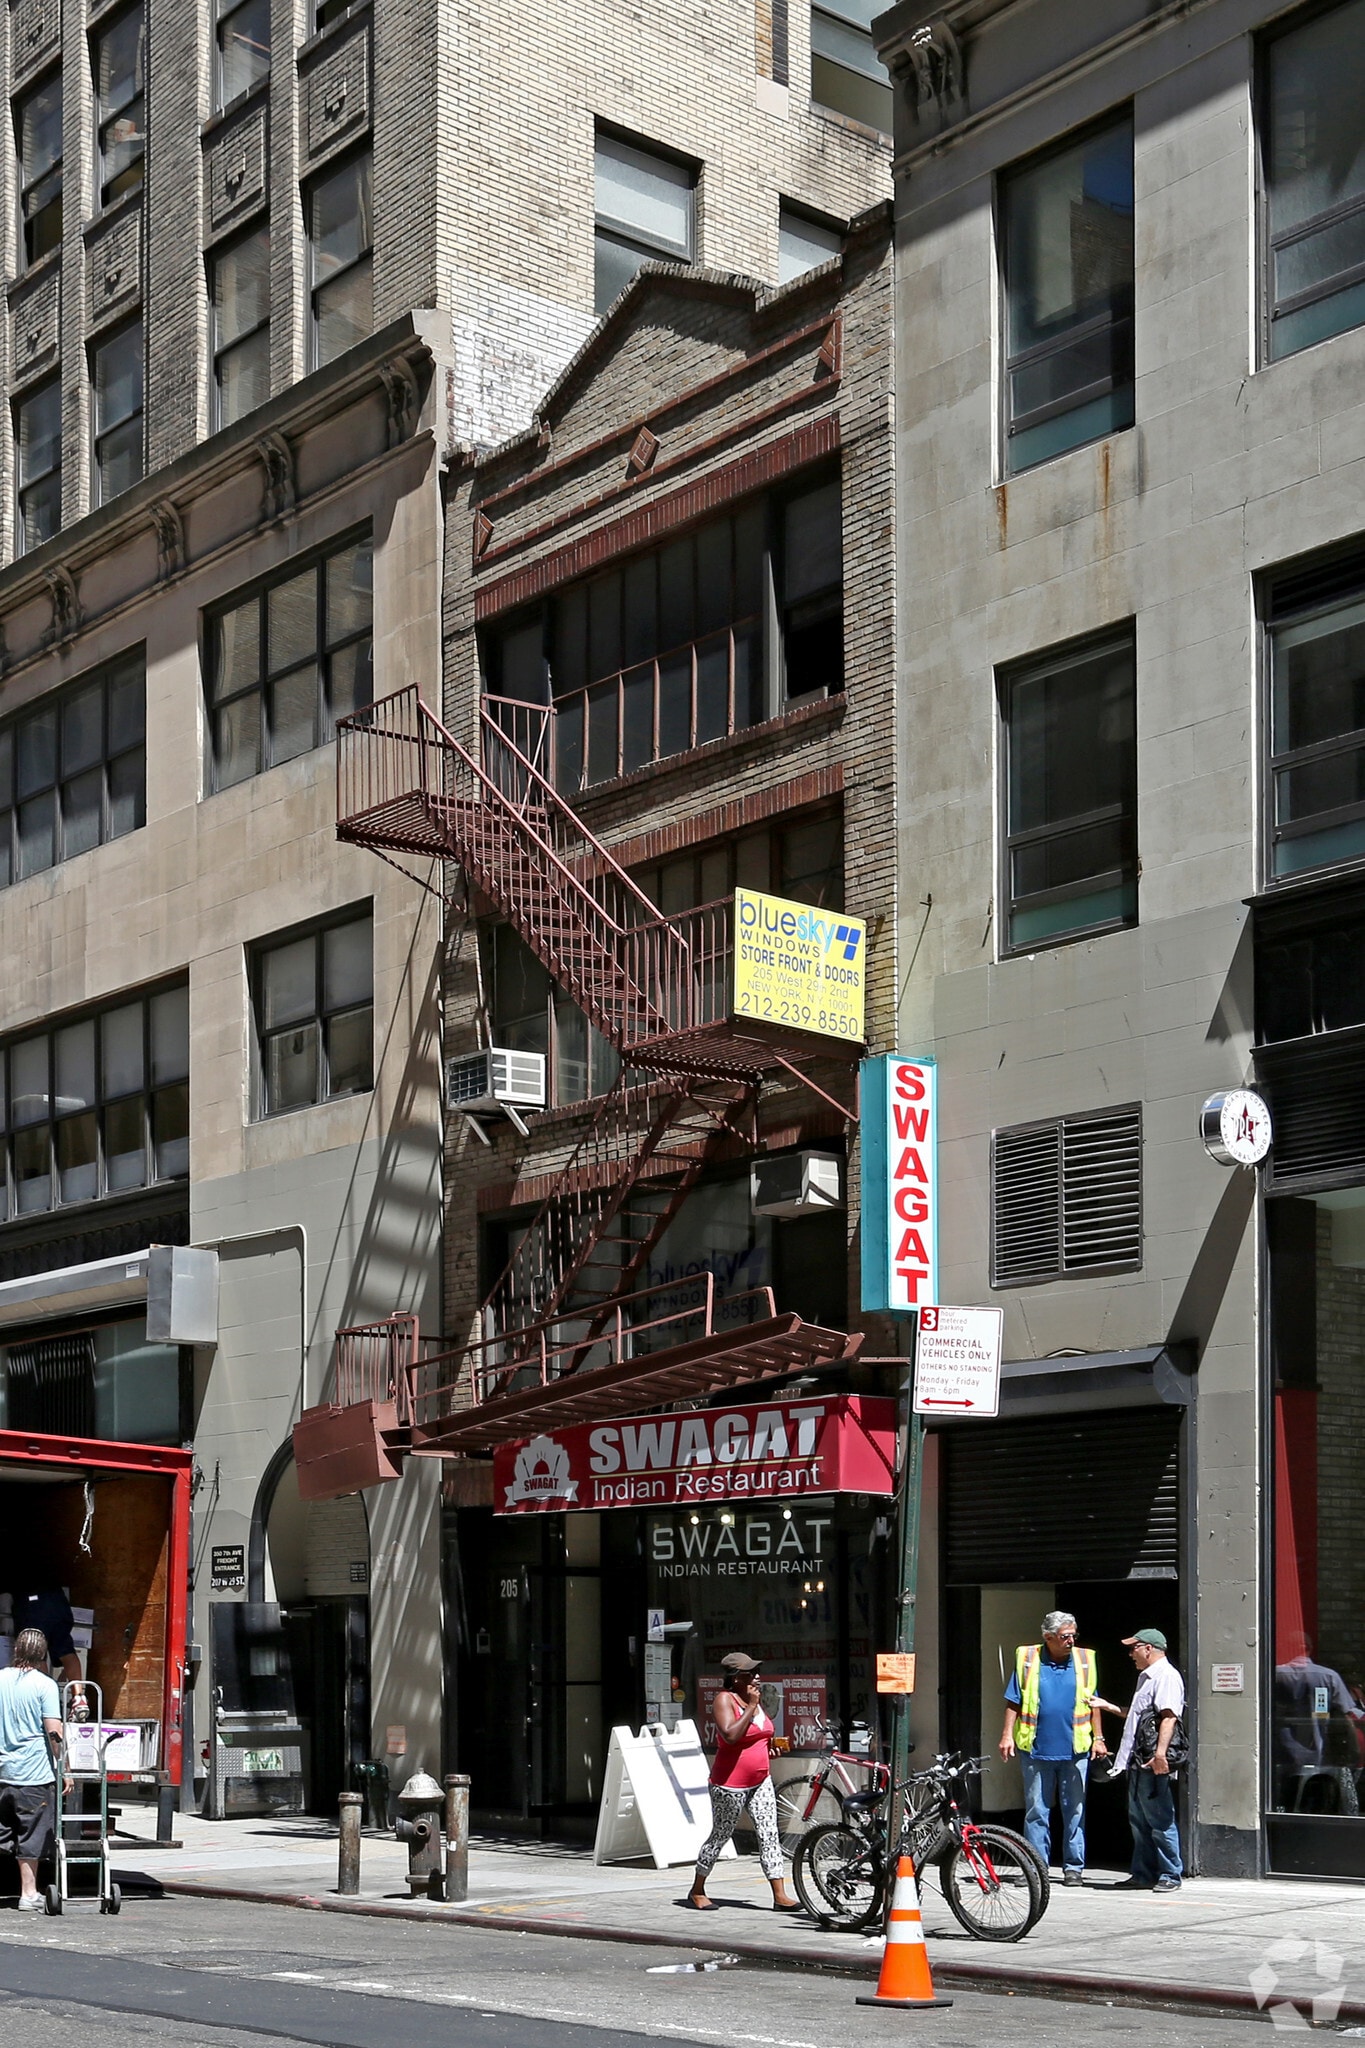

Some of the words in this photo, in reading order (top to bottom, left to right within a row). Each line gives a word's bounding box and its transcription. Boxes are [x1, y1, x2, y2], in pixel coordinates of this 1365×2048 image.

[740, 893, 836, 953] bluesky
[740, 929, 820, 958] WINDOWS
[741, 944, 775, 967] STORE
[778, 953, 812, 975] FRONT
[815, 963, 822, 978] &
[825, 965, 860, 987] DOORS
[752, 966, 773, 981] 205
[777, 970, 803, 987] West
[830, 985, 848, 999] 2nd
[747, 980, 771, 993] NEW
[829, 998, 854, 1013] 10001
[741, 992, 858, 1037] 212-239-8550
[1223, 1091, 1247, 1119] ORGANIC
[1250, 1094, 1269, 1126] COFFEE
[1224, 1133, 1251, 1161] NATURAL
[1253, 1139, 1267, 1157] FOOD
[892, 1064, 930, 1304] SWAGAT
[647, 1286, 724, 1309] WINDOS
[922, 1308, 937, 1330] 3
[922, 1337, 983, 1349] COMMERCIAL
[922, 1349, 966, 1359] VEHICLES
[968, 1350, 992, 1360] ONLY
[920, 1376, 949, 1385] Monday
[956, 1377, 980, 1387] Friday
[960, 1365, 993, 1373] STANDING
[920, 1385, 936, 1393] 8am
[944, 1386, 960, 1395] 6pm
[588, 1405, 825, 1474] SWAGAT
[524, 1477, 560, 1492] SWAGAT
[594, 1477, 666, 1502] Indian
[674, 1463, 821, 1496] Restaurant
[652, 1518, 831, 1560] SWAGAT
[658, 1561, 712, 1578] INDIAN
[717, 1559, 824, 1576] RESTAURANT
[500, 1578, 518, 1598] 205
[652, 1613, 662, 1633] A
[812, 1678, 826, 1688] COMBO
[793, 1722, 817, 1748] $8.95
